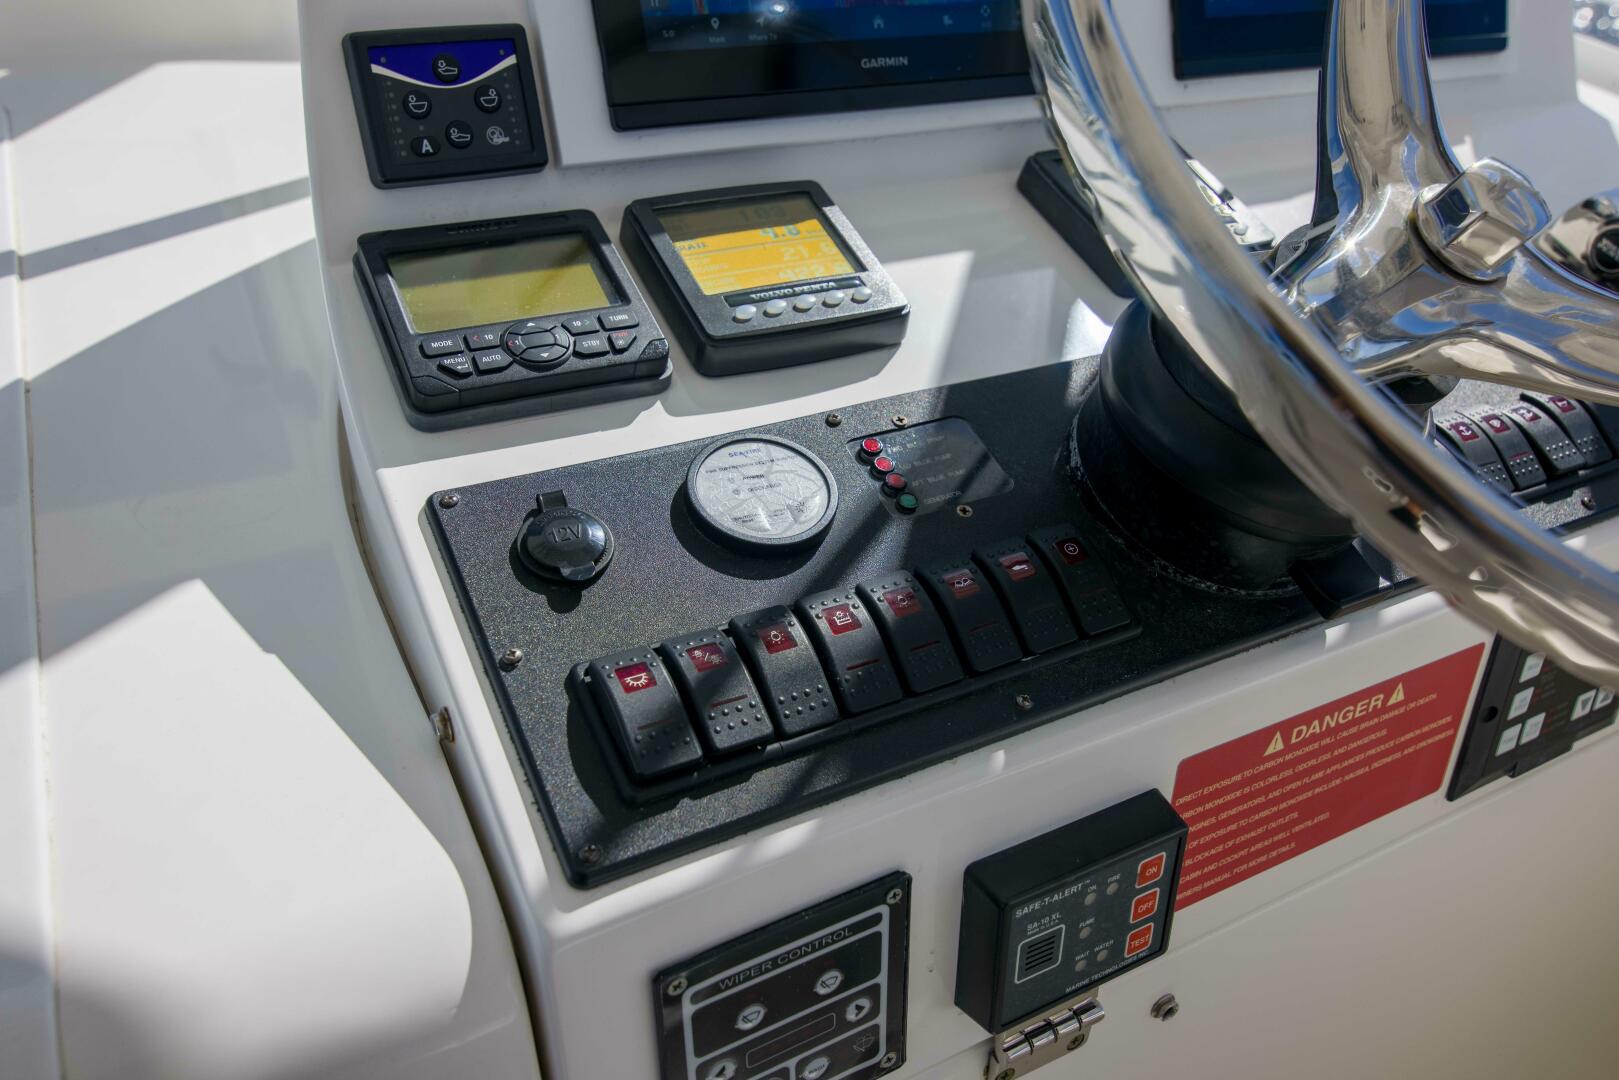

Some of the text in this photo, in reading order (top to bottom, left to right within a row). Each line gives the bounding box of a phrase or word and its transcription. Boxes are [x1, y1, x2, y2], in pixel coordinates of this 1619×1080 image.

[860, 56, 909, 69] GARMIN
[421, 139, 434, 153] A
[750, 281, 837, 300] VOLVO PENTA
[608, 313, 629, 322] TURN
[430, 339, 454, 349] MODE
[582, 339, 601, 348] STBY
[443, 355, 466, 365] MENU
[481, 353, 502, 363] AUTO
[548, 524, 583, 544] 12V
[1290, 693, 1385, 745] DANGER
[1176, 790, 1201, 805] DIRECT
[1202, 774, 1241, 794] EXPOSURE
[1242, 769, 1252, 777] TO
[1254, 756, 1284, 772] CARBON
[1284, 742, 1319, 760] MONOXIDE
[1320, 735, 1336, 745] WILL
[1204, 790, 1242, 810] MONOXIDE
[1332, 746, 1347, 756] AND
[1266, 789, 1282, 799] AND
[1200, 823, 1238, 843] EXPOSURE
[1224, 840, 1235, 848] OF
[1236, 826, 1266, 843] EXHAUST
[1202, 862, 1218, 873] AND
[1220, 849, 1248, 866] COCKPIT
[1146, 865, 1158, 875] ON
[1234, 864, 1248, 873] FOR
[1087, 884, 1097, 893] ON
[1138, 901, 1154, 913] OFF
[1051, 912, 1061, 920] XL
[1079, 917, 1095, 928] FUME
[1094, 939, 1114, 952] WATER
[1130, 934, 1150, 949] TEST
[718, 927, 853, 990] WIPER CONTROL
[1065, 978, 1090, 993] MARINE
